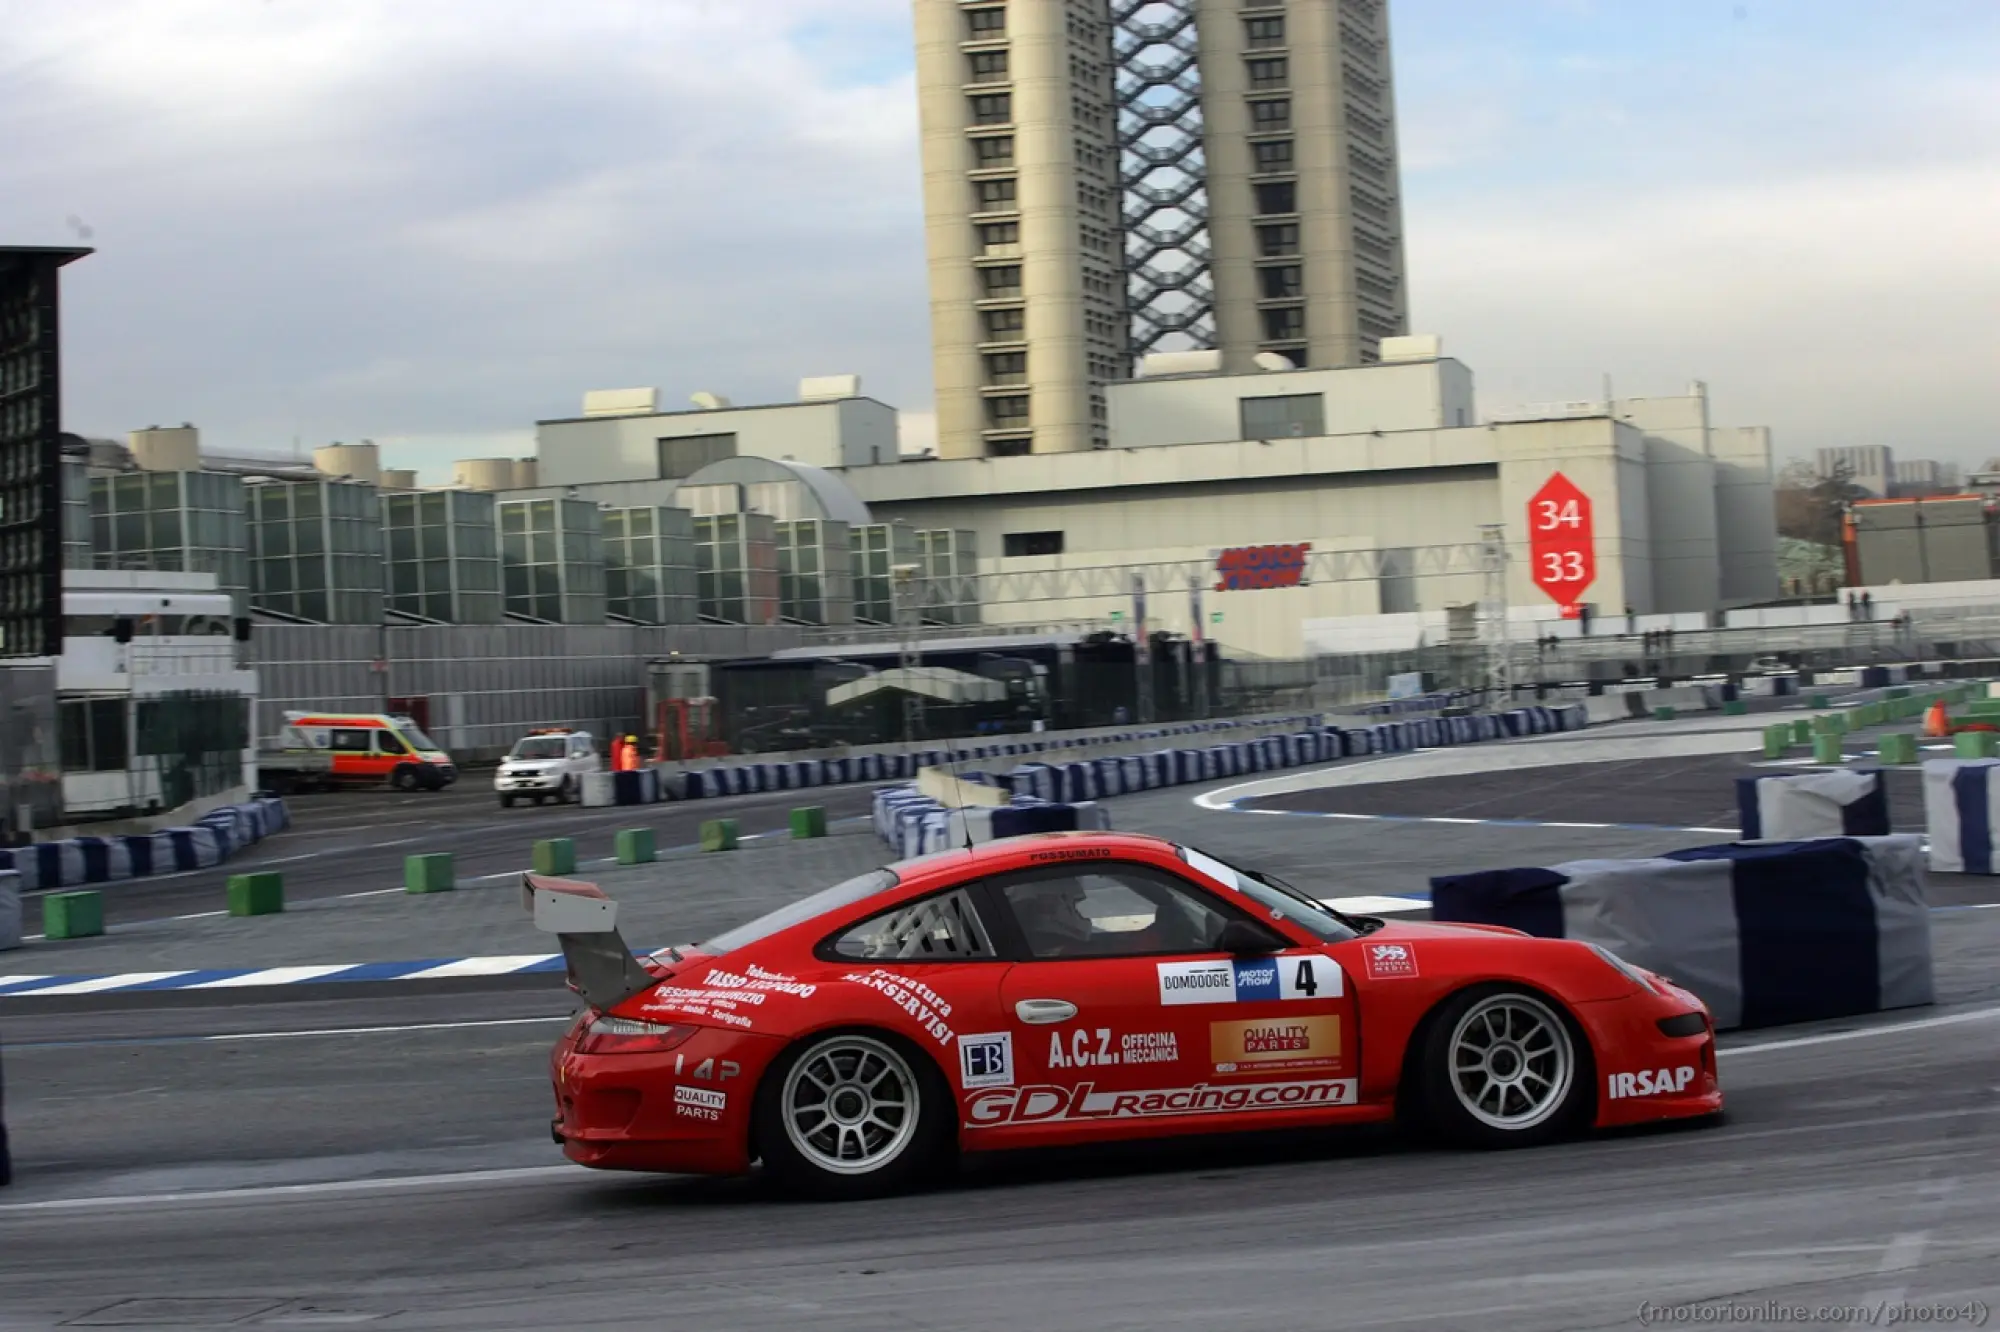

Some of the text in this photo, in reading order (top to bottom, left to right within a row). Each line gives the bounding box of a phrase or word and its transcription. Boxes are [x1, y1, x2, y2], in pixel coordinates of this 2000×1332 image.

[1537, 499, 1583, 530] 34
[1541, 550, 1585, 582] 33
[703, 969, 747, 988] TASSO
[1295, 960, 1317, 996] 4
[841, 974, 954, 1046] MANSERVISI
[1121, 1032, 1177, 1049] OFFICINA
[1244, 1026, 1308, 1040] QUALITY
[1247, 1039, 1301, 1051] PARTS
[966, 1043, 1004, 1076] FB
[1048, 1028, 1119, 1068] A.C.Z.
[1123, 1048, 1179, 1064] MECCANICA
[1608, 1066, 1695, 1099] IRSAP
[676, 1089, 724, 1106] QUALITY
[676, 1105, 719, 1121] PARTS
